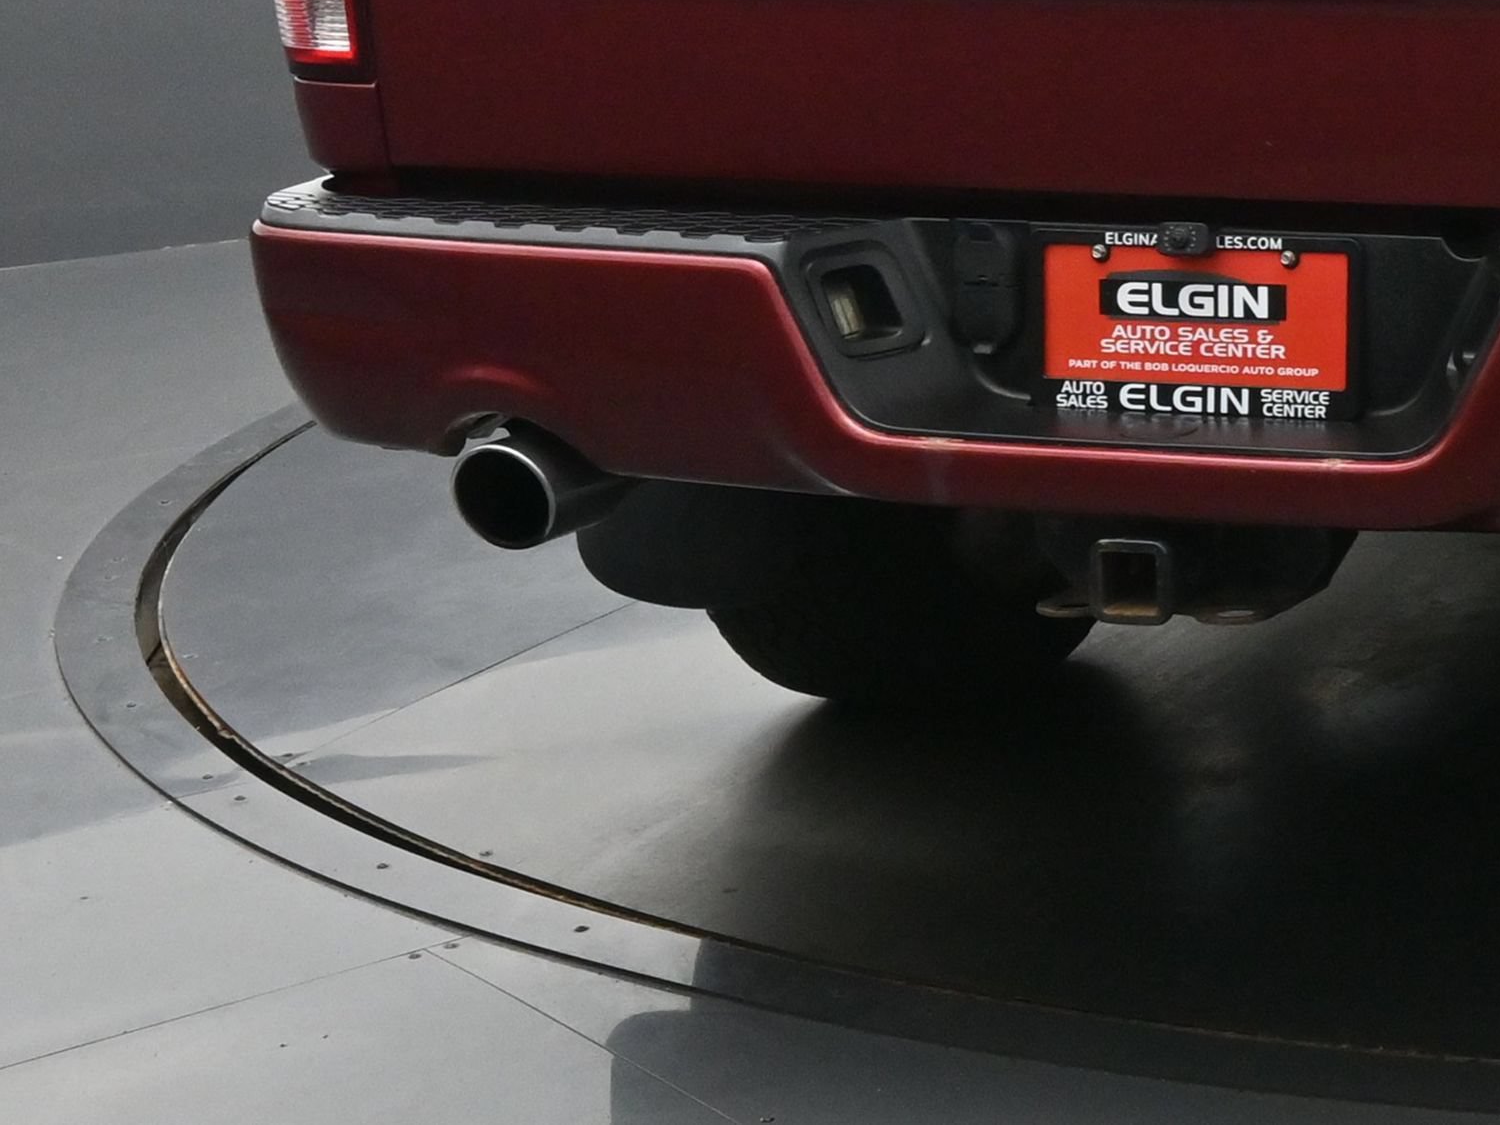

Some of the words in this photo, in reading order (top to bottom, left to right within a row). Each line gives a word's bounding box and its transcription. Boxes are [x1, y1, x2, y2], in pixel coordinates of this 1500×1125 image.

[1117, 282, 1269, 319] ELGIN
[1112, 324, 1170, 340] AUTO
[1178, 327, 1249, 343] SALES
[1257, 329, 1274, 343] &
[1100, 339, 1192, 356] SERVICE
[1199, 343, 1286, 360] CENTER
[1069, 359, 1099, 369] PART
[1101, 360, 1117, 369] OF
[1120, 361, 1142, 371] THE
[1144, 362, 1169, 372] BOB
[1172, 364, 1239, 374] LOQUERCIO
[1243, 366, 1274, 375] AUTO
[1278, 367, 1319, 377] GROUP
[1060, 381, 1105, 394] AUTO
[1056, 394, 1108, 408] SALES
[1119, 383, 1250, 415] ELGIN
[1260, 389, 1330, 405] SERVICE
[1262, 404, 1326, 418] CENTER
